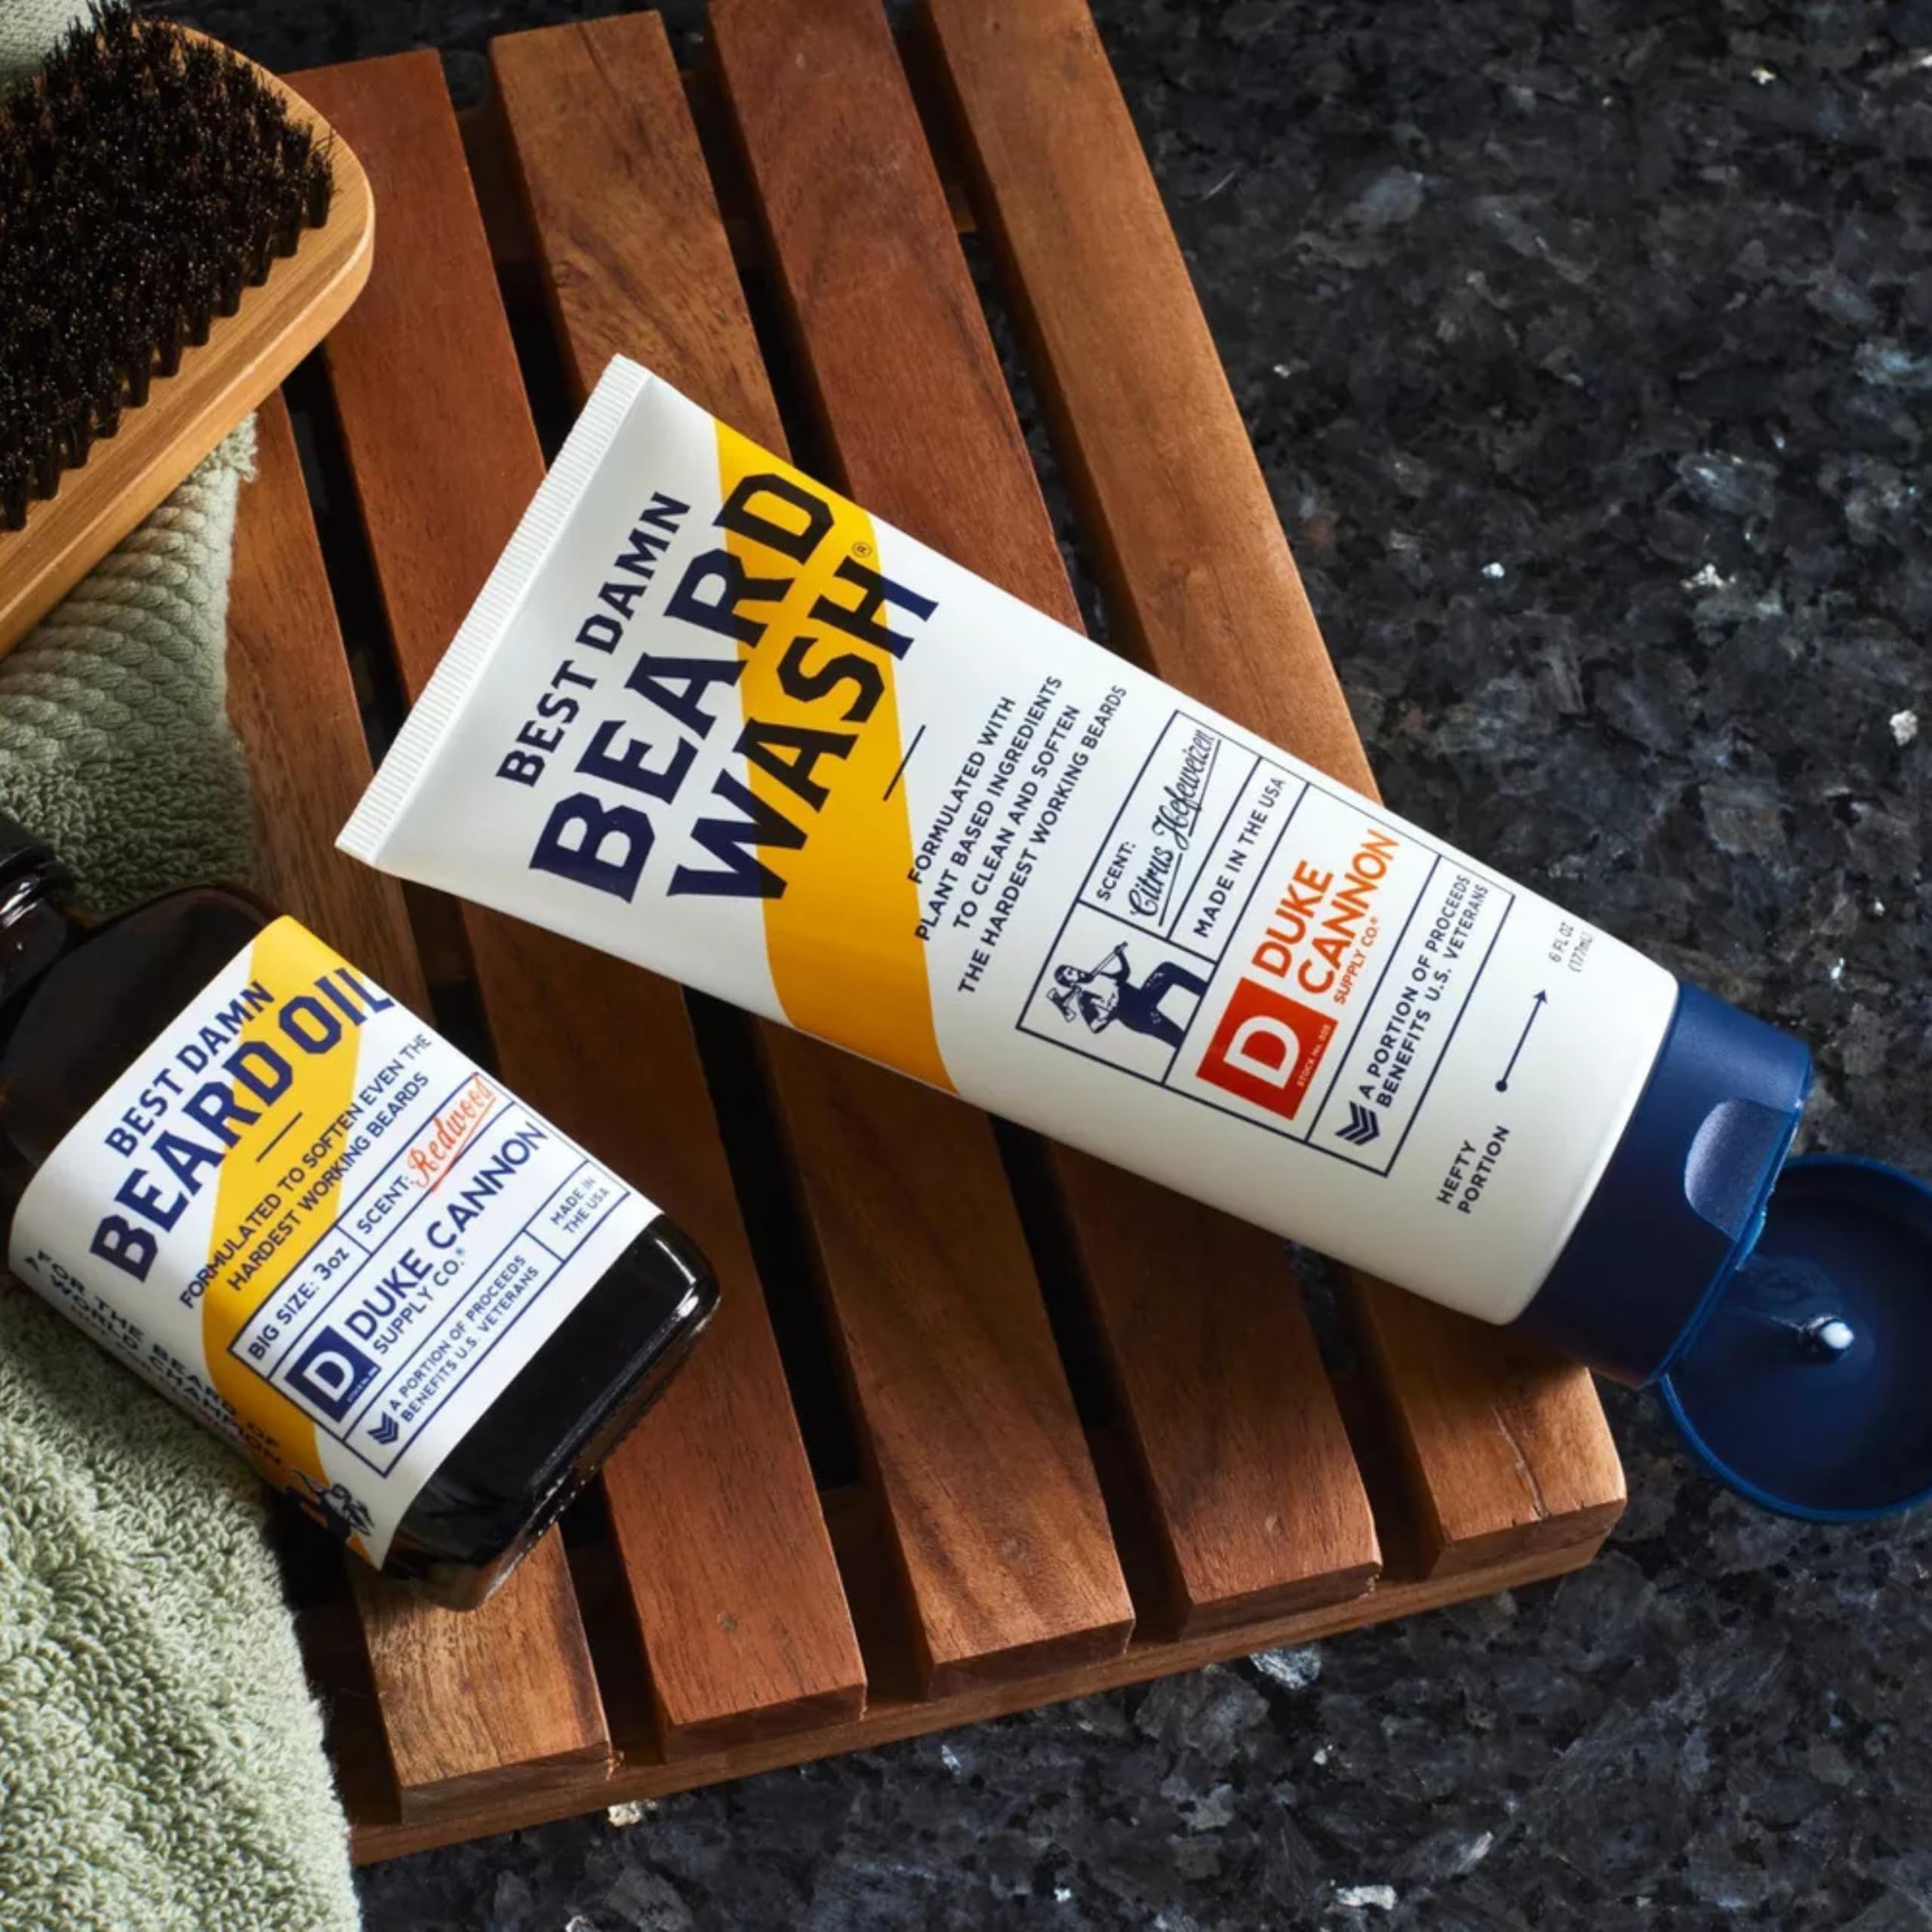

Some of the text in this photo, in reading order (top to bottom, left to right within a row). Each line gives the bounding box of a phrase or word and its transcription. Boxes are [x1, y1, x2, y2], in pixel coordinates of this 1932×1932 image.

[496, 491, 691, 786] BEST DAMN
[529, 472, 835, 903] BEARD
[908, 696, 1016, 884] FORMULATED WITH
[915, 675, 1063, 942] PLANT BASED INGREDIENTS
[953, 704, 1081, 929] TO CLEAN AND SOFTEN
[958, 685, 1128, 995] THE HARDEST WORKING BEARDS
[1097, 841, 1137, 902] SCENT:
[1128, 729, 1215, 917] Citrus Hefeweizen
[1193, 777, 1286, 937] MADE IN THE USA
[1251, 859, 1334, 978] DUKE
[1297, 829, 1400, 995] CANNON
[1333, 950, 1367, 1005] SUPPLY
[1358, 875, 1471, 1100] A PORTION OF PROCEEDS
[1549, 952, 1561, 962] 6
[104, 980, 275, 1158] BEST DAMN
[1223, 1015, 1301, 1091] D
[1375, 884, 1489, 1108] BENEFITS U.S. VETERANS
[89, 1041, 294, 1283] BEARD
[279, 968, 395, 1054] OIL
[180, 1033, 432, 1309] FORMULATED TO SOFTEN EVEN THE
[226, 1072, 429, 1291] HARDEST WORKING BEARDS
[356, 1075, 495, 1235] SCENT: Redwood
[550, 1177, 596, 1226] MADE IN
[1436, 1139, 1476, 1204] HEFTY
[1457, 1125, 1510, 1214] PORTION
[344, 1121, 549, 1341] DUKE CANNON
[563, 1187, 610, 1234] THE USA
[24, 1257, 39, 1272] A
[50, 1274, 139, 1350] WORLD
[149, 1355, 281, 1465] CHAMPION
[38, 1251, 280, 1447] FOR THE BEARD OF
[248, 1247, 350, 1359] BIG SIZE: 3oz
[303, 1351, 355, 1402] D
[374, 1287, 434, 1355] SUPPLY
[389, 1255, 526, 1411] A PORTION OF PROCEEDS
[401, 1266, 539, 1423] BENEFITS U.S. VETERANS
